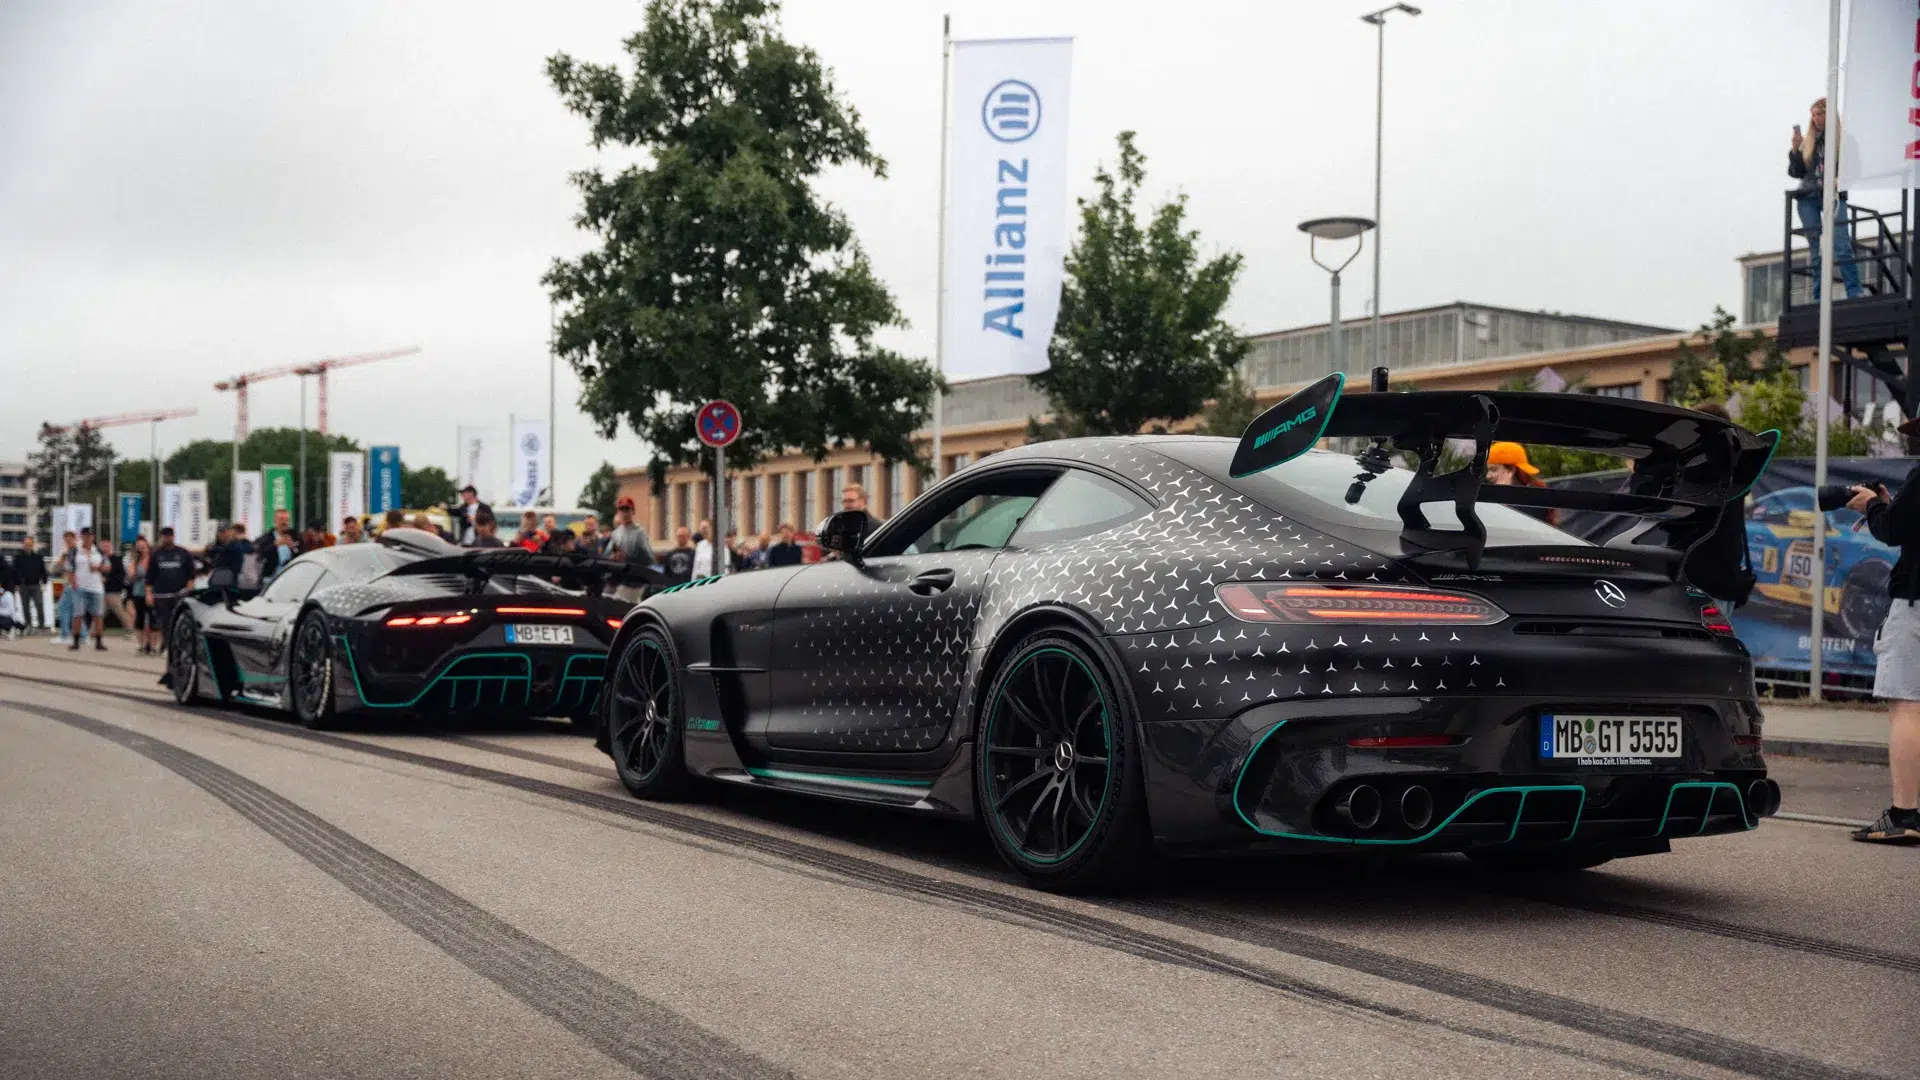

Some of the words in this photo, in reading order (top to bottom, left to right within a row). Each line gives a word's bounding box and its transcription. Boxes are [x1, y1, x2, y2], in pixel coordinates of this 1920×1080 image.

[982, 157, 1028, 340] Allianz
[1272, 405, 1317, 439] AMG
[1791, 554, 1811, 576] 150
[516, 626, 533, 640] MB
[542, 627, 559, 641] ET
[1798, 635, 1855, 652] BISTEIN
[1544, 741, 1549, 751] D
[1556, 720, 1582, 753] MB
[1599, 720, 1624, 753] GT
[1630, 721, 1678, 753] 5555
[1581, 757, 1592, 765] hob
[1620, 757, 1629, 765] bin
[1629, 757, 1652, 765] Rentner.
